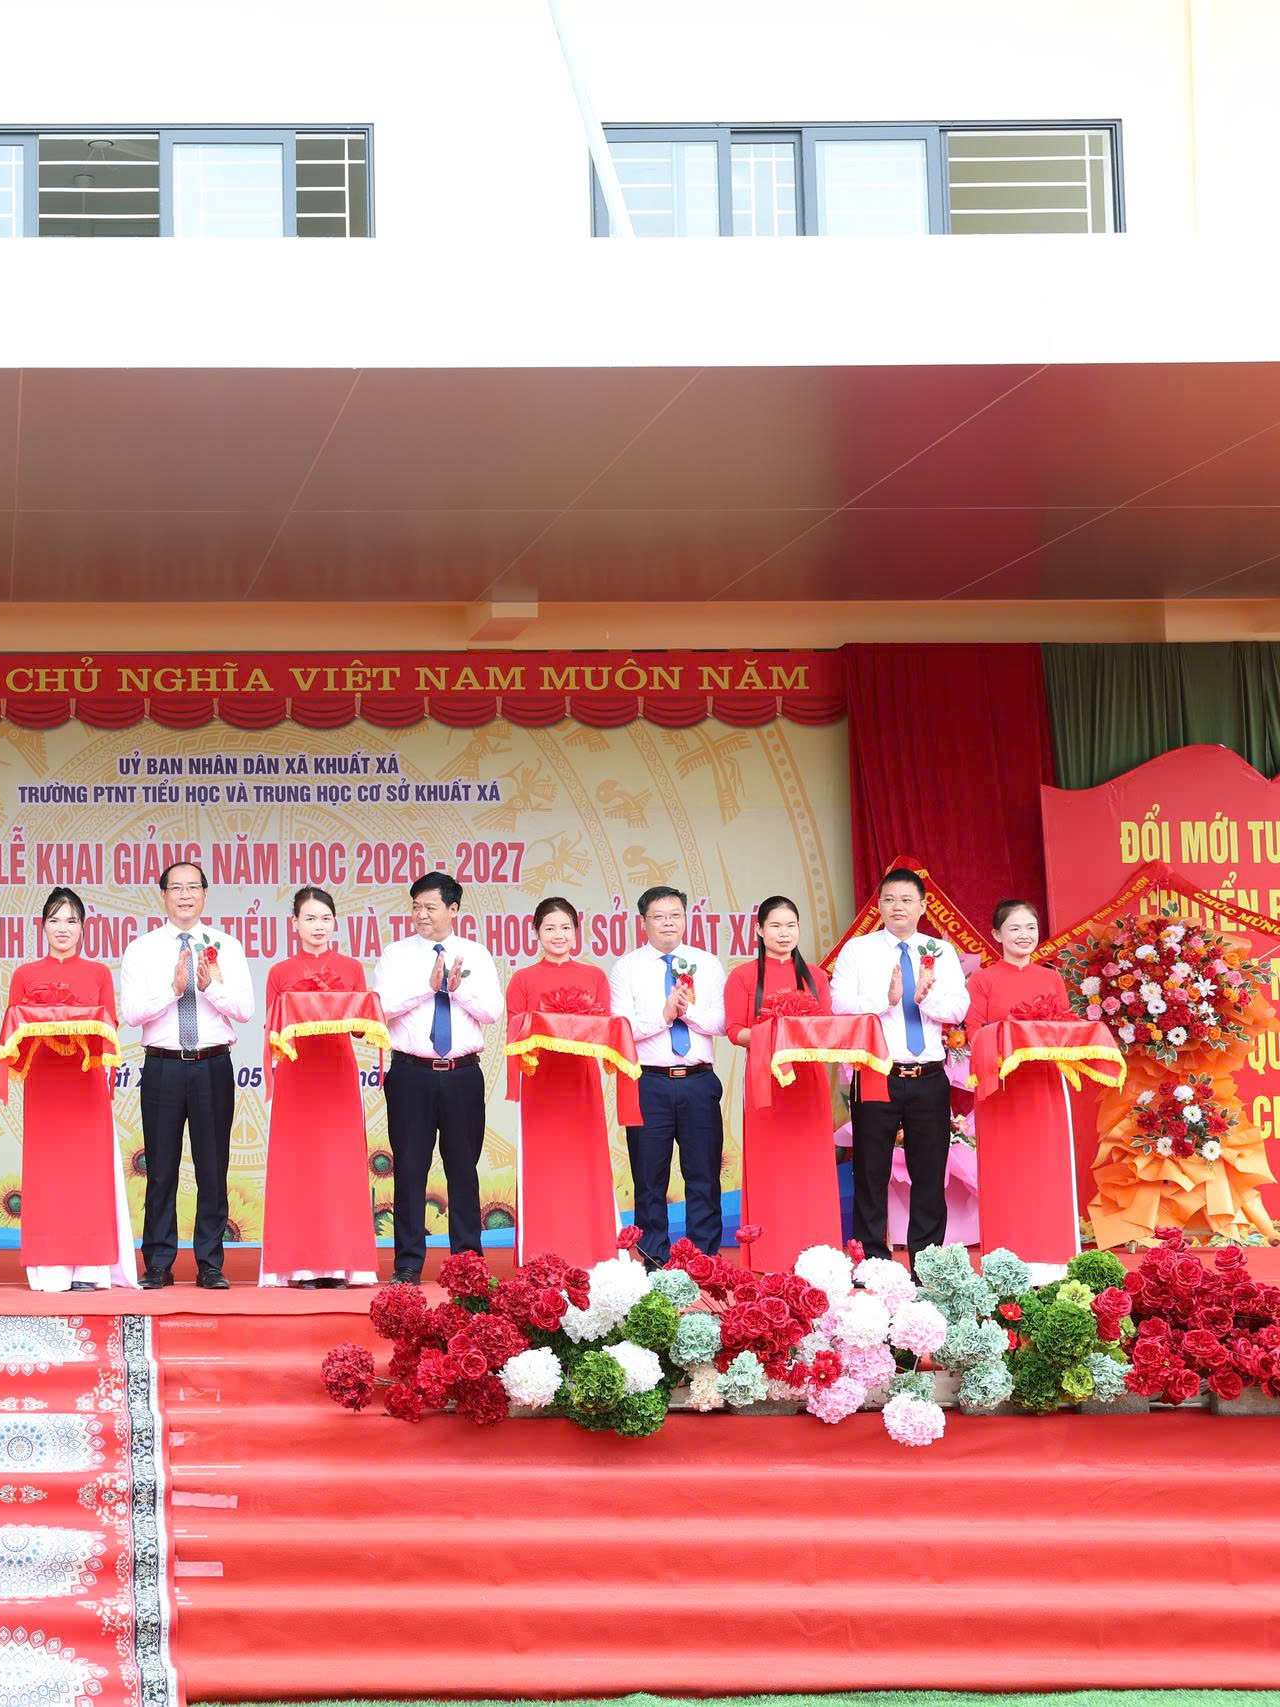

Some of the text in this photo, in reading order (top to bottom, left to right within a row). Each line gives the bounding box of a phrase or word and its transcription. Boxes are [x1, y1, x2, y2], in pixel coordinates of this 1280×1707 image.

[5, 657, 102, 693] CHỦ
[117, 661, 274, 692] NGHĨA
[289, 659, 401, 698] VIỆT
[415, 666, 526, 691] NAM
[539, 658, 683, 690] MUÔN
[698, 658, 810, 690] NĂM
[119, 751, 400, 775] UỶ BAN NHÂN DÂN XÃ KHUẤT XÁ
[18, 778, 500, 806] TRƯỜNG PTNT TIỂU HỌC VÀ TRUNG HỌC CƠ SỞ KHUẤT XÁ
[1120, 803, 1171, 864] ĐỔI
[1180, 812, 1239, 864] MỚI
[36, 843, 104, 885] KHAI
[212, 833, 278, 885] NĂM
[356, 842, 425, 885] 2026
[435, 861, 446, 870] -
[456, 842, 525, 884] 2027
[33, 905, 138, 959] TỜNG
[348, 906, 381, 957] VÀ
[486, 914, 539, 966] HỌC
[592, 896, 628, 957] SỞ
[237, 1067, 263, 1088] 05
